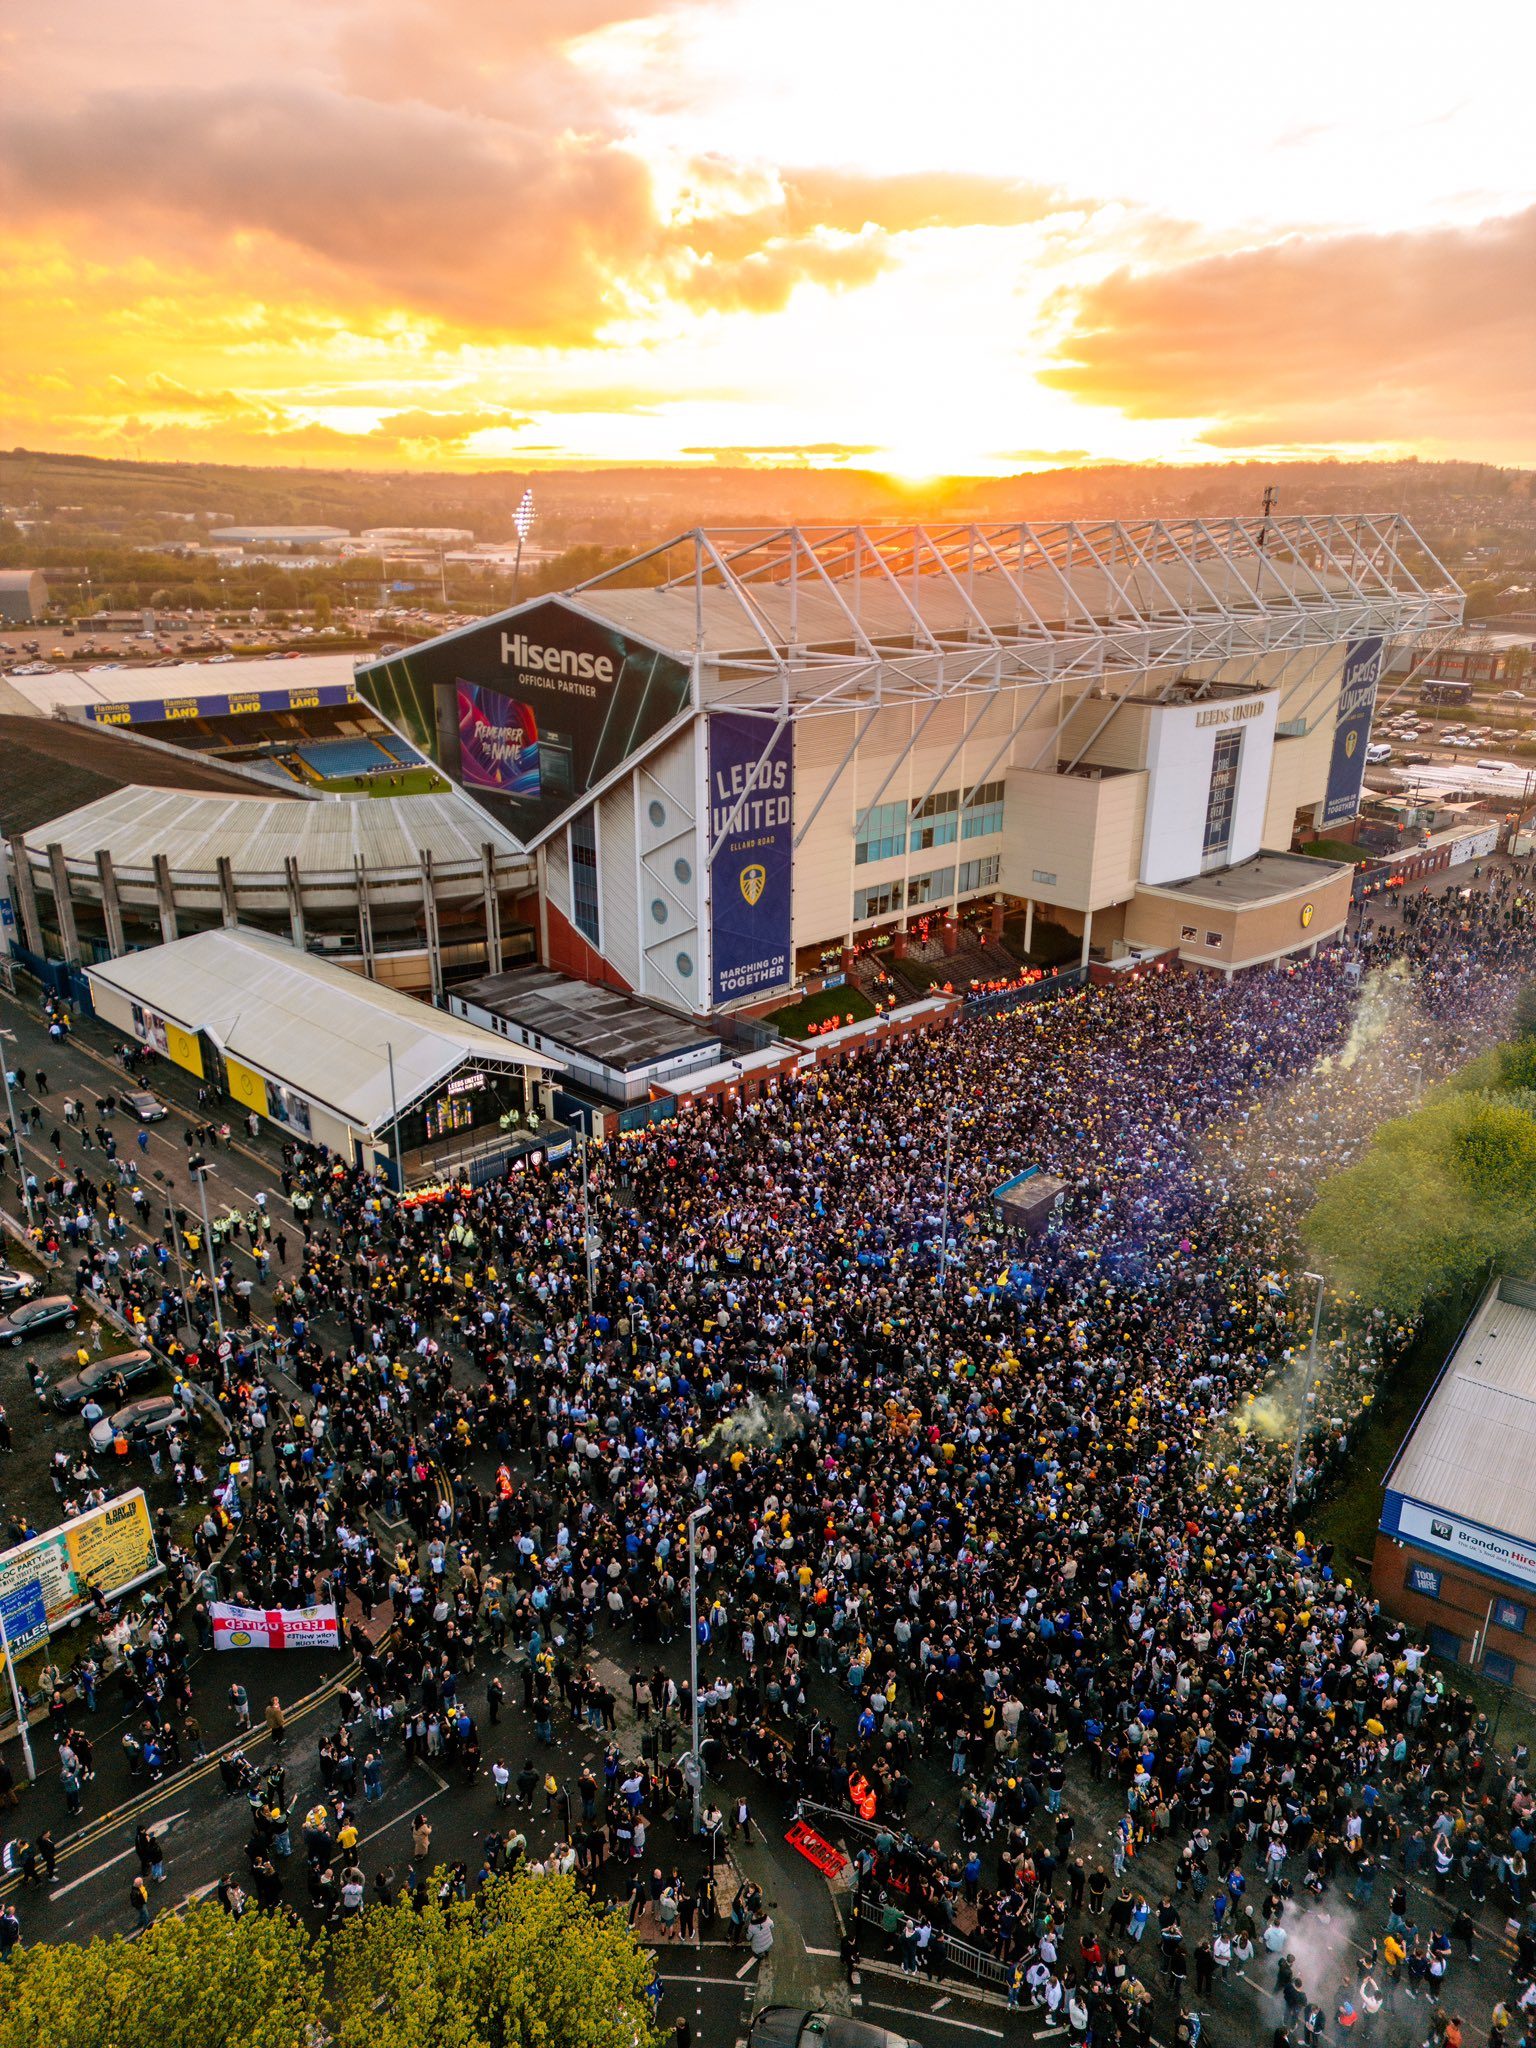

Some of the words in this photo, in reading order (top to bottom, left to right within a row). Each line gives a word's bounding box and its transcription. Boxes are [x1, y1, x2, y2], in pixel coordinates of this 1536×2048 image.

[501, 632, 613, 682] Hisense
[519, 673, 556, 690] OFFICIAL
[558, 680, 597, 698] PARTNER
[94, 703, 130, 712] flamingo
[163, 698, 198, 707] flamingo
[290, 697, 320, 709] LAND
[347, 693, 359, 704] LA
[165, 707, 199, 719] LAND
[229, 702, 262, 714] LAND
[1195, 709, 1232, 728] LEEDS
[1233, 700, 1264, 721] UNITED
[96, 713, 132, 725] LAND
[475, 721, 523, 742] REMEMBER
[716, 760, 788, 800] LEEDS
[713, 795, 791, 837] UNITED
[730, 839, 755, 853] ELLAND
[757, 835, 776, 847] ROAD
[720, 959, 769, 980] MARCHING
[771, 955, 785, 966] ON
[720, 965, 785, 993] TOGETHER
[448, 1079, 465, 1090] LEEDS
[464, 1074, 484, 1085] UNITED
[105, 1512, 111, 1521] A
[112, 1506, 126, 1517] DAY
[128, 1502, 137, 1510] TO
[1458, 1531, 1510, 1557] Brandon
[1511, 1552, 1536, 1567] Hire
[17, 1554, 42, 1572] PARTY
[1507, 1559, 1536, 1574] Equipmen
[1415, 1569, 1437, 1582] TOOL
[1417, 1579, 1437, 1591] HIRE
[13, 1621, 48, 1646] TILES
